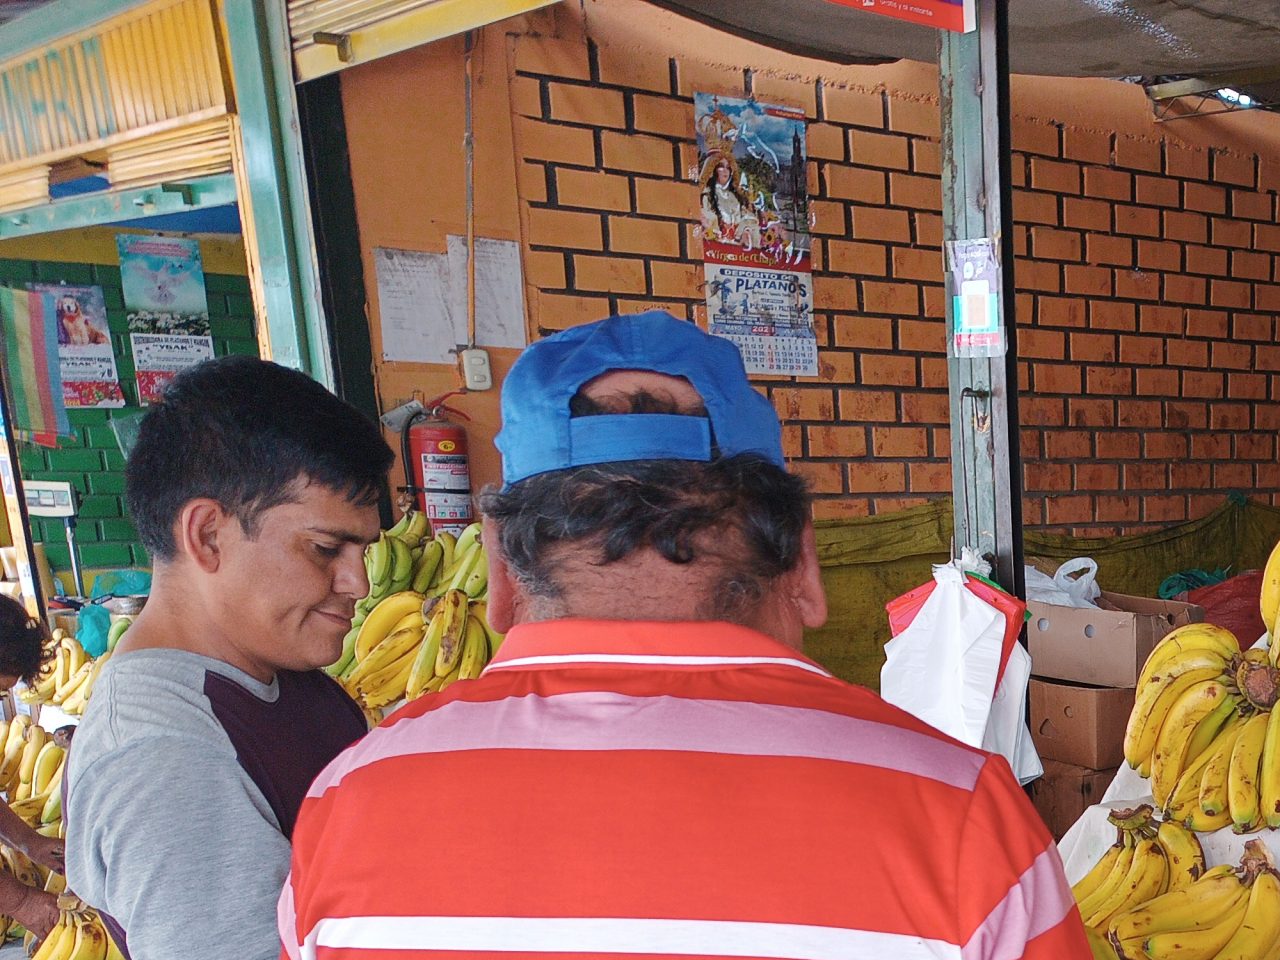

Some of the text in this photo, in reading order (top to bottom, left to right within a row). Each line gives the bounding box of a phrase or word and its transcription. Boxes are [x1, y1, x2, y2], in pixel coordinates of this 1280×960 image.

[706, 249, 738, 263] Virgn
[724, 269, 778, 280] DEPOSITO
[736, 278, 807, 298] PLATANOS
